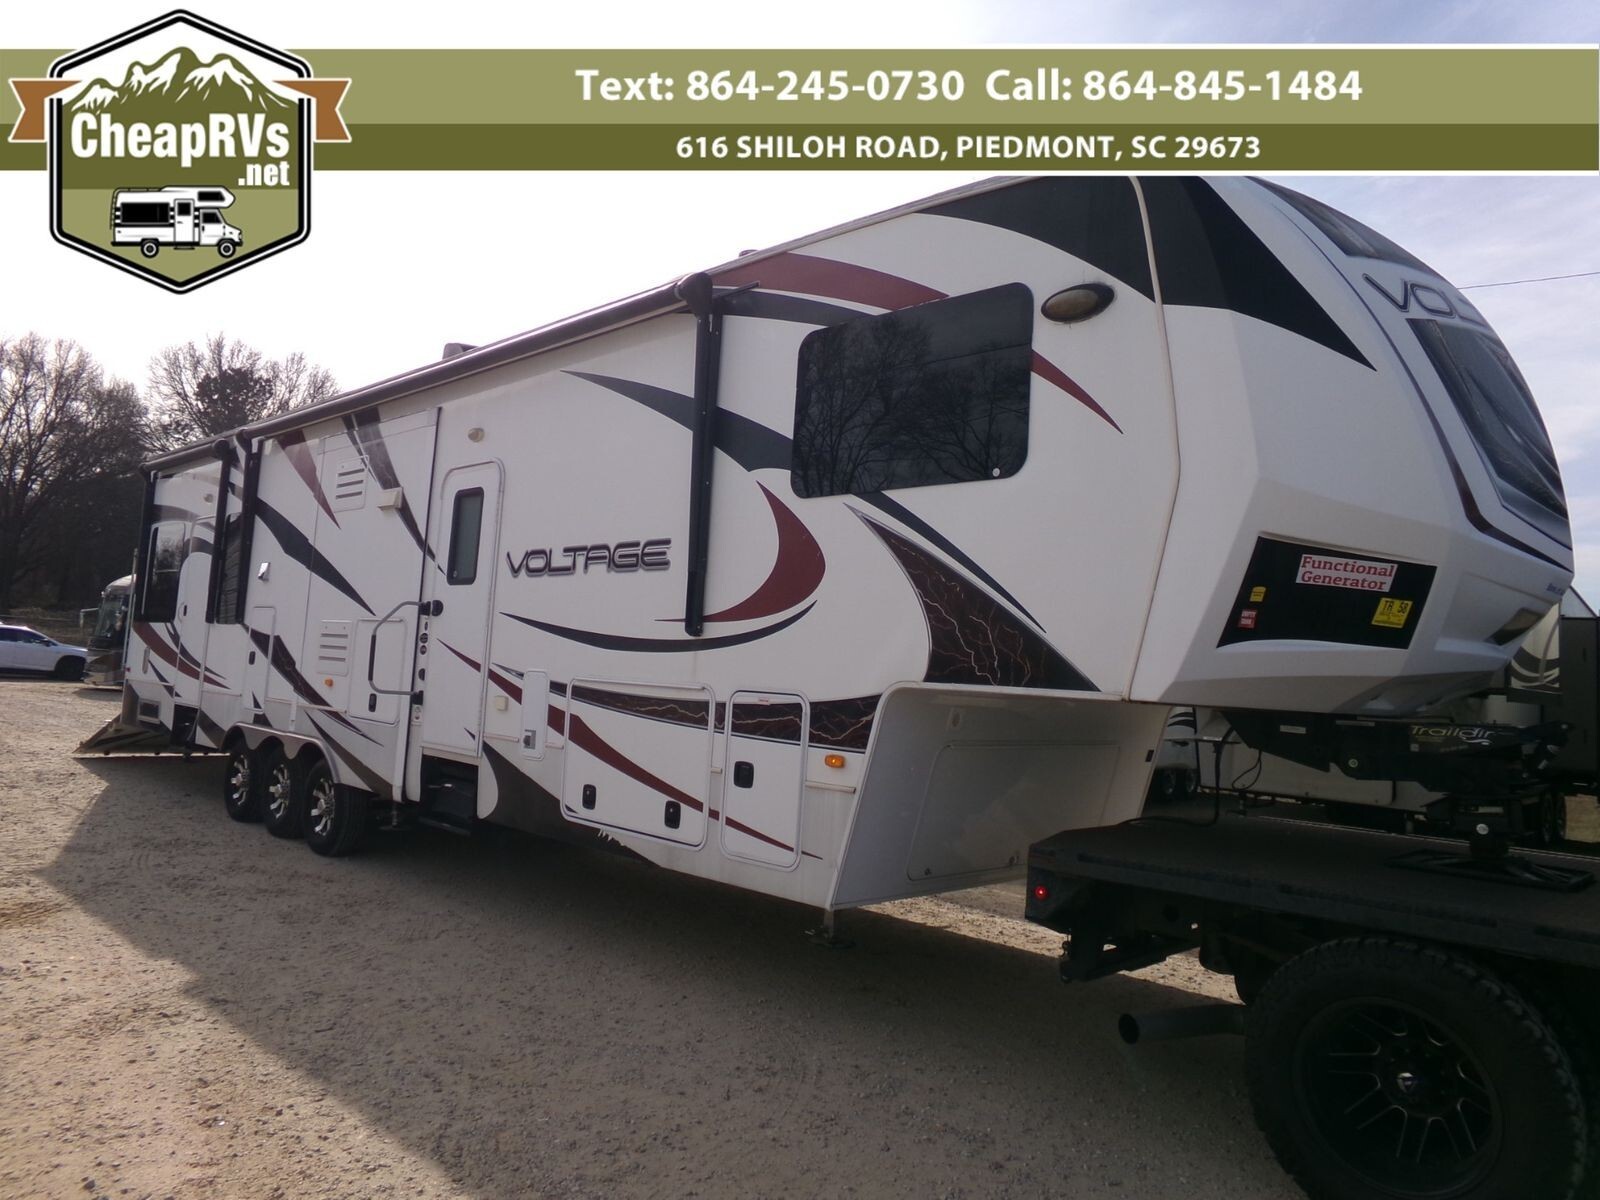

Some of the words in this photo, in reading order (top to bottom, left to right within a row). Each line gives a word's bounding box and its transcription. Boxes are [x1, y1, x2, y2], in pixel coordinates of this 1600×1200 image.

[506, 538, 672, 577] VOLTAGE
[1301, 556, 1395, 577] Functional
[1301, 571, 1386, 591] Generator
